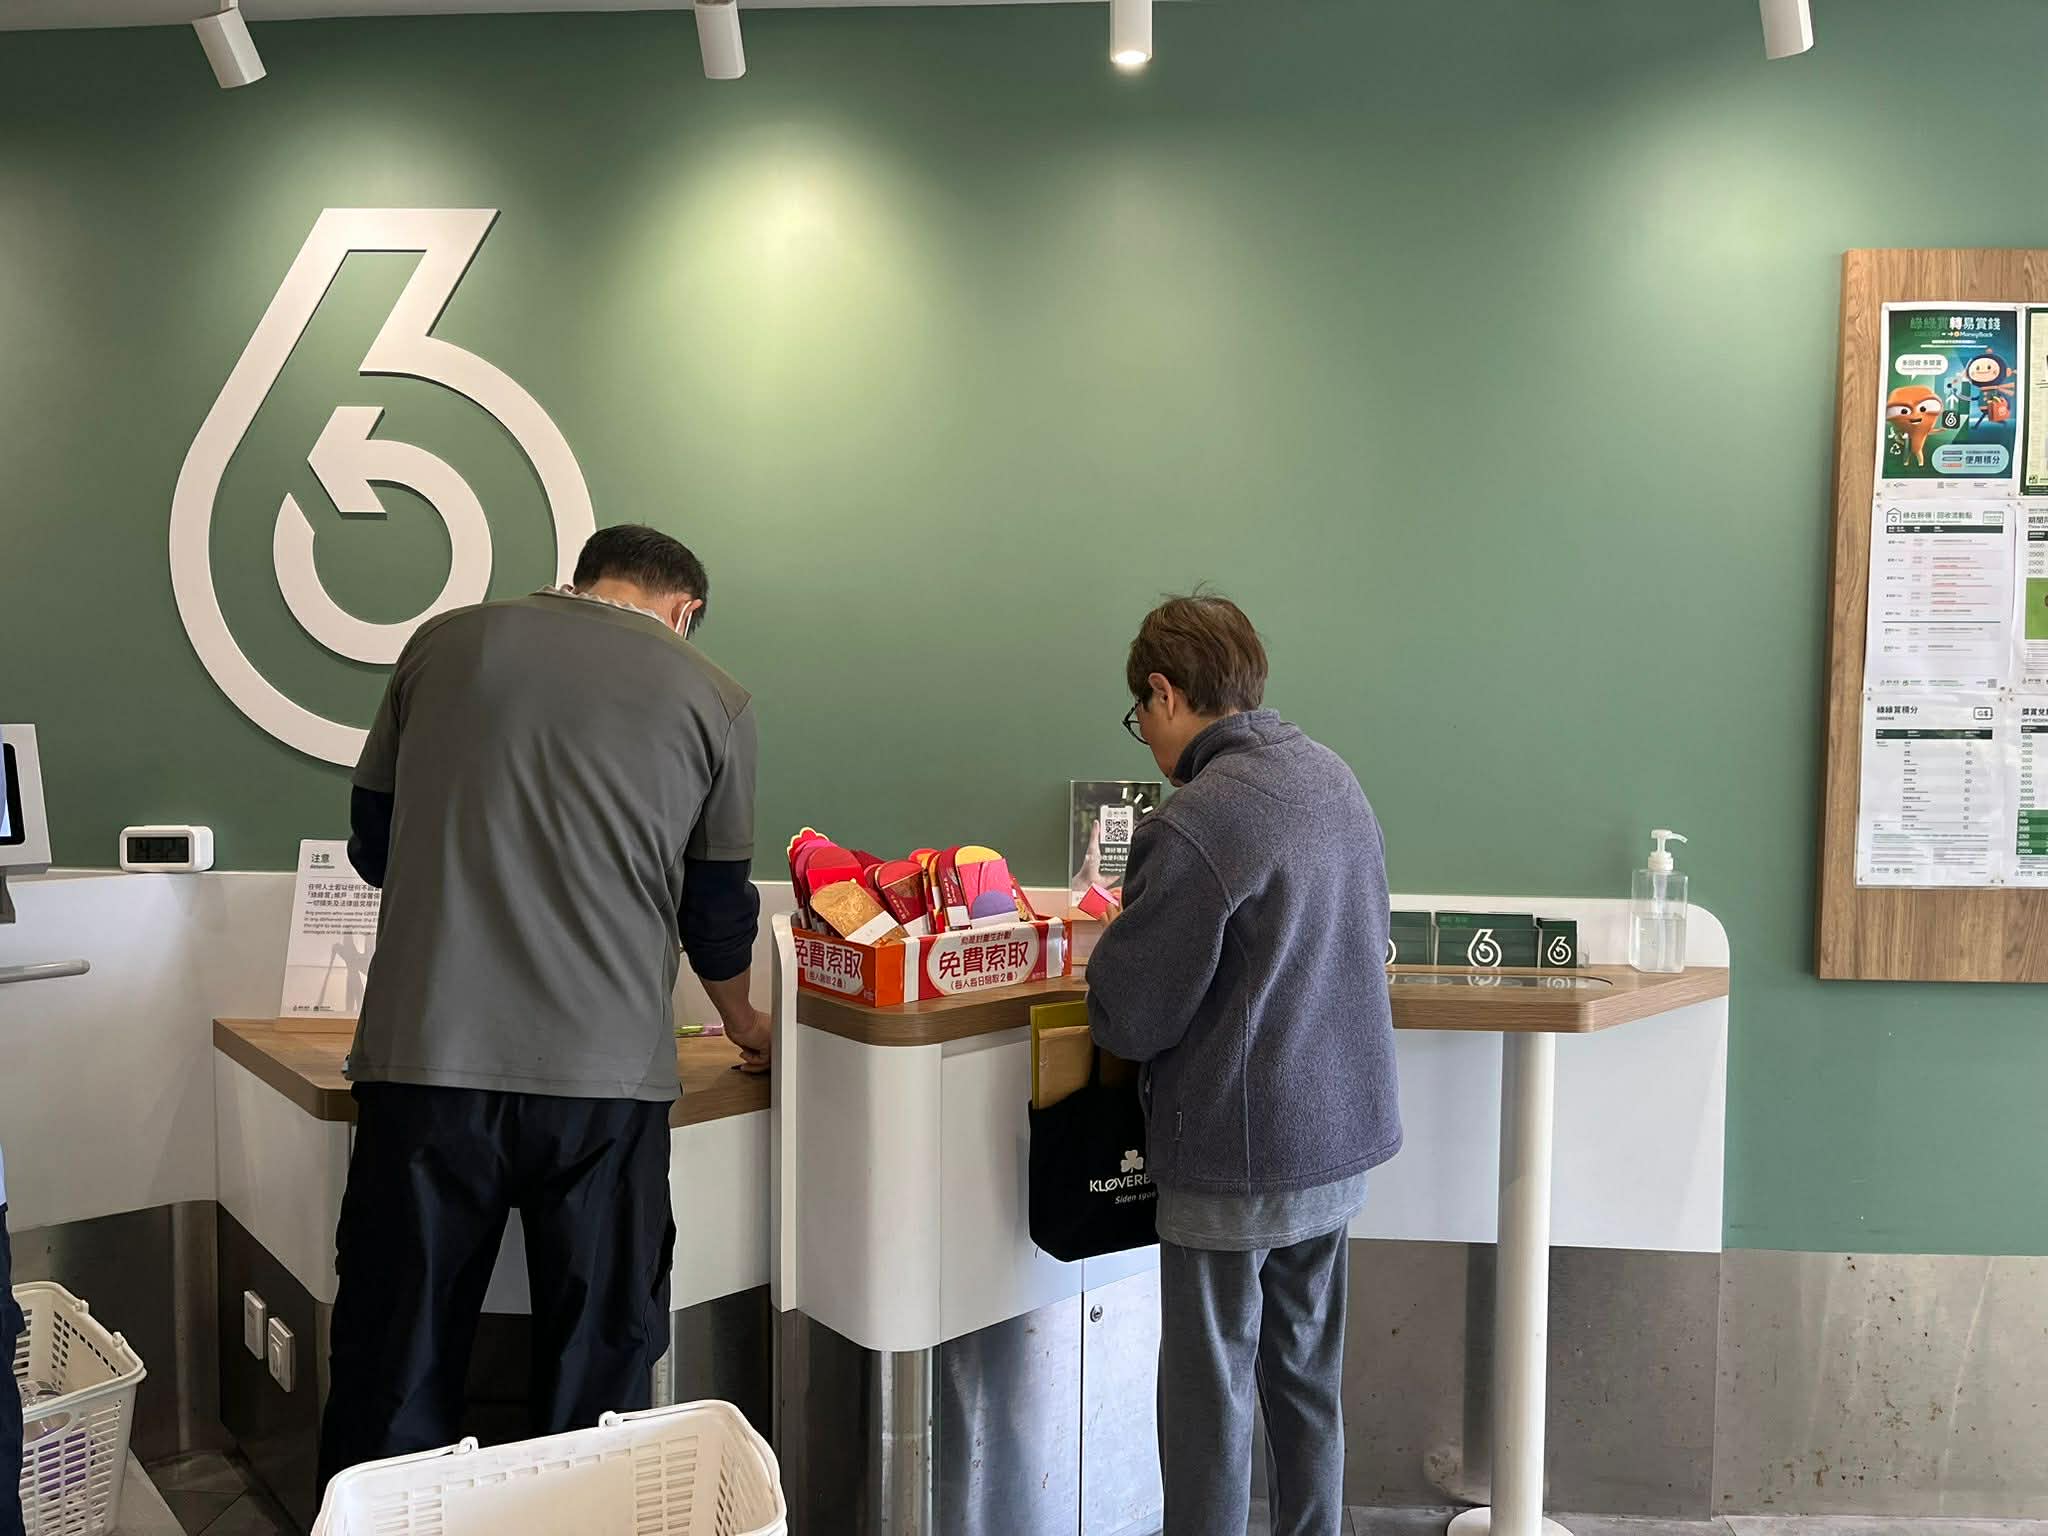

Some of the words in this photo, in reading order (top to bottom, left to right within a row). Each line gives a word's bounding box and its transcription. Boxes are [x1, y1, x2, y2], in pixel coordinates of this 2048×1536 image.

[311, 853, 330, 863] 注意
[939, 941, 1029, 979] 免費索取
